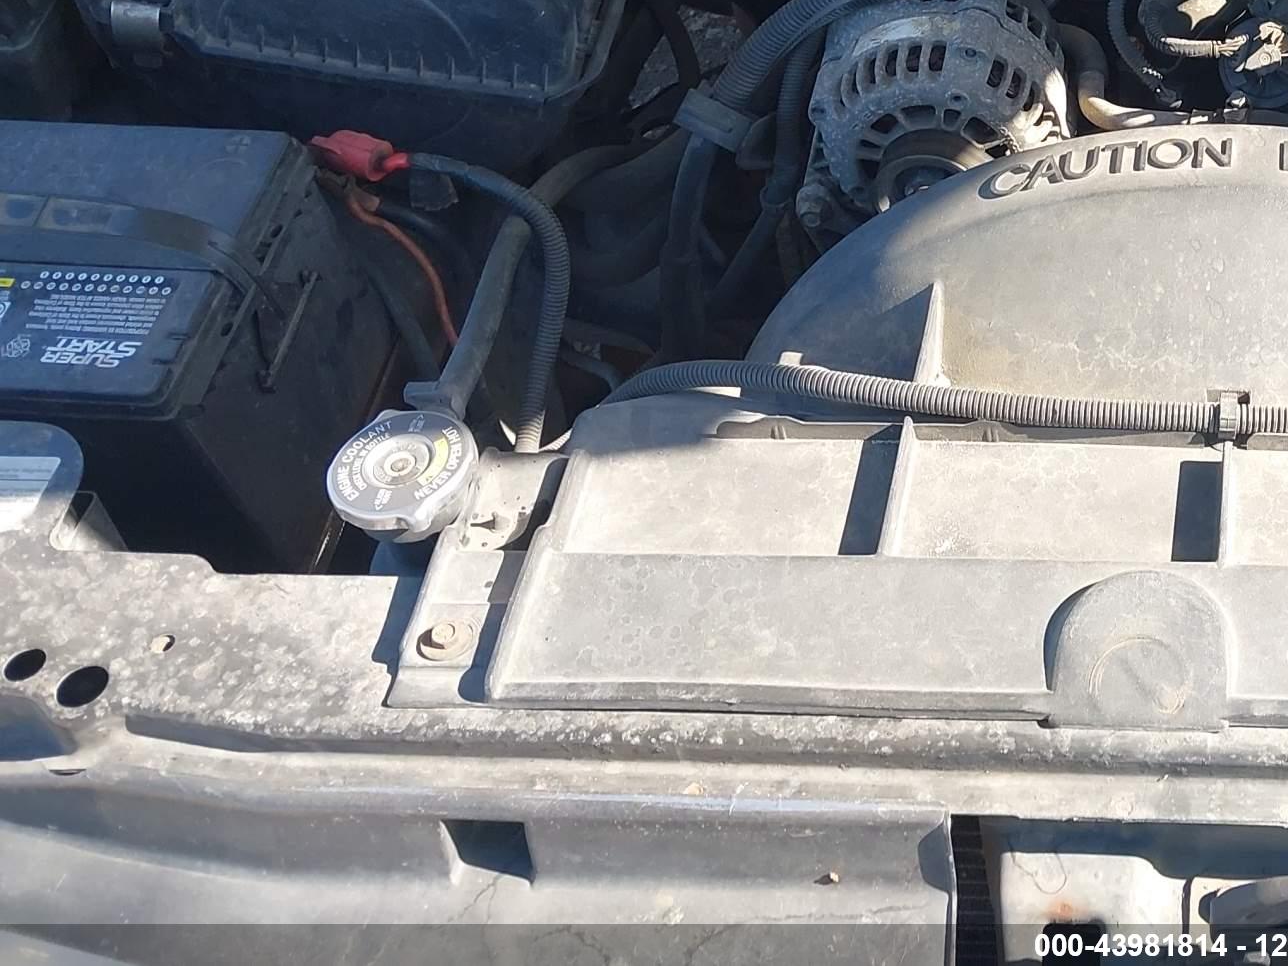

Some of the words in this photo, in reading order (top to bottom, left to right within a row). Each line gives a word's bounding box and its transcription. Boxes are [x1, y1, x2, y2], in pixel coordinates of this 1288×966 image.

[978, 137, 1233, 200] CAUTION
[40, 351, 123, 368] SUPER
[47, 338, 143, 357] START
[341, 420, 392, 463] COOLANT
[441, 426, 461, 445] HOT
[447, 442, 462, 470] OPEN
[337, 465, 360, 502] ENGINE
[413, 470, 452, 501] NEVER
